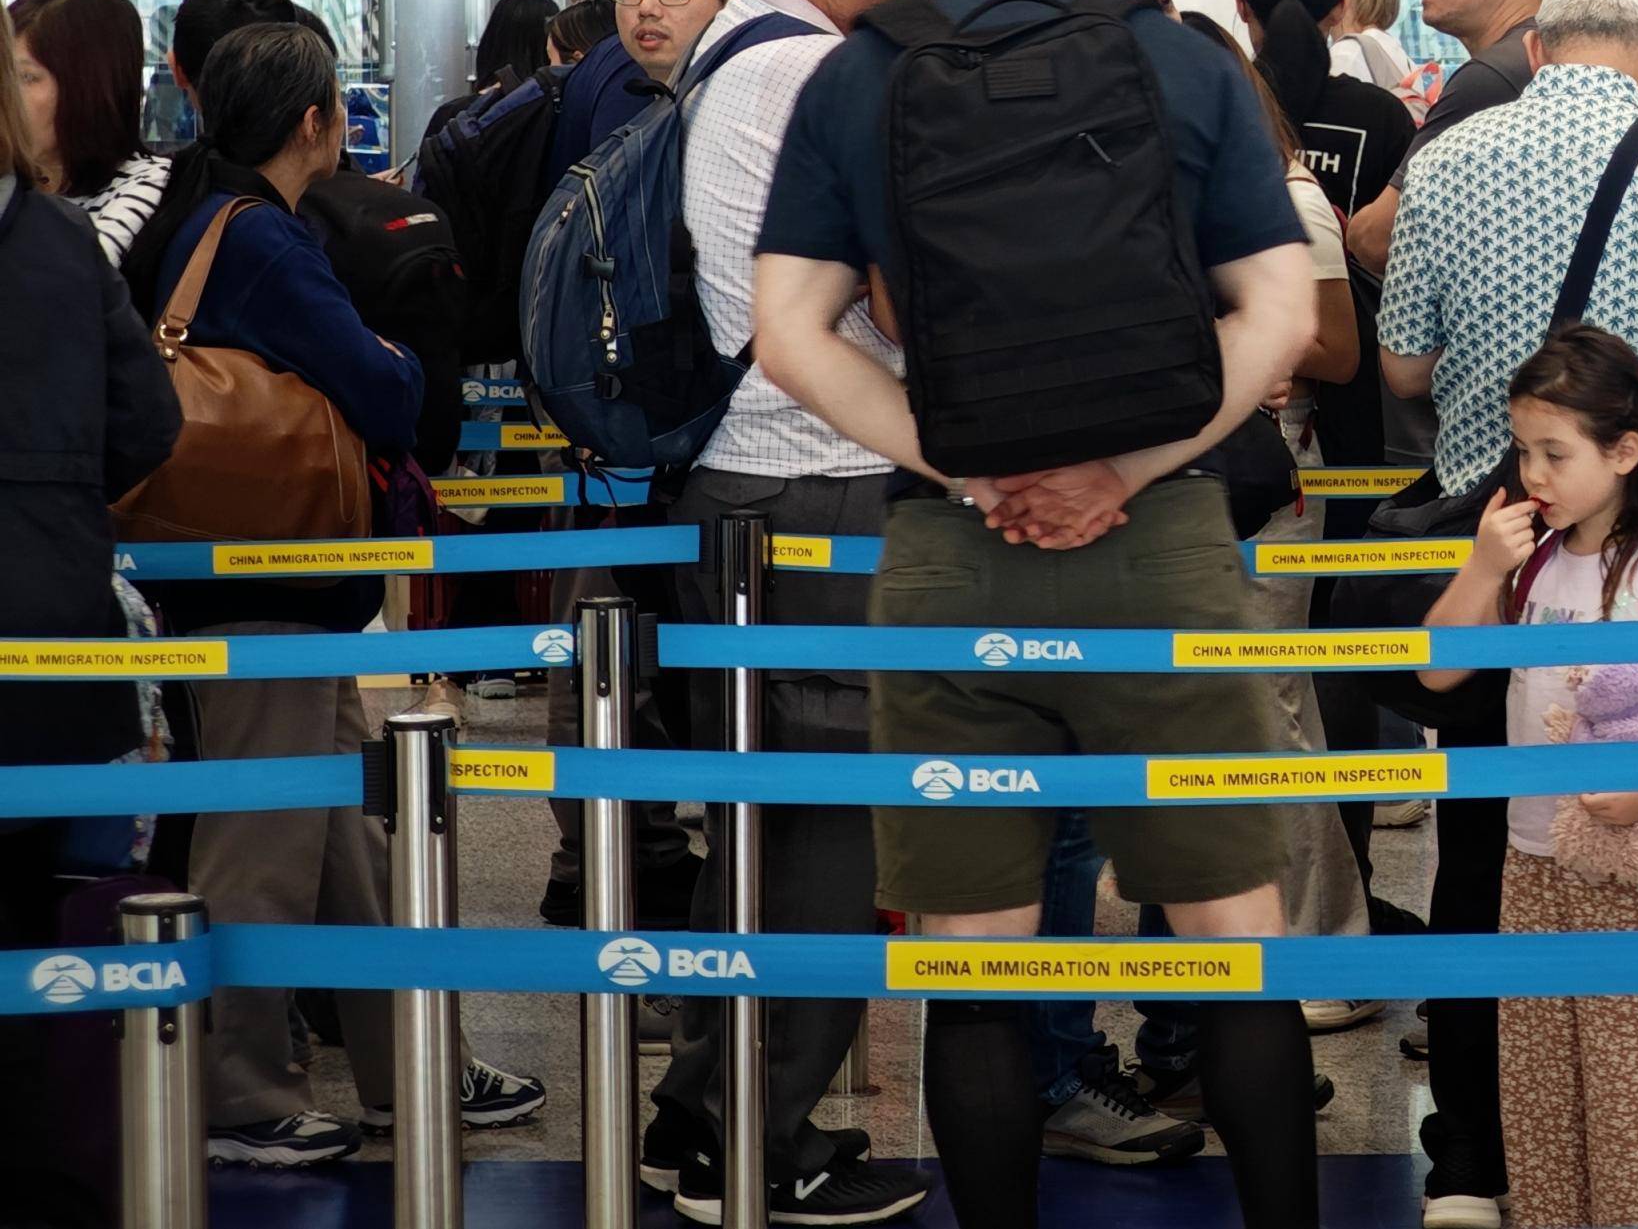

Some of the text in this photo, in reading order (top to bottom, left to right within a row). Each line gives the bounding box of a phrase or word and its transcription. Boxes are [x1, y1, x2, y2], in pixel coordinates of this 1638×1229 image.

[489, 486, 548, 496] INSPECTION
[1302, 478, 1369, 489] IMMIGRATION
[228, 551, 415, 566] CHINA IMMIGRATION INSPECTION
[1271, 550, 1457, 565] CHINA IMMIGRATION INSPECTION
[1022, 639, 1083, 660] BCIA
[1192, 643, 1409, 657] CHINA IMMIGRATION INSPECTION
[35, 654, 124, 665] IMMIGRATION
[130, 653, 207, 665] INSPECTION
[968, 768, 1041, 793] BCIA
[1169, 767, 1422, 787] CHINA IMMIGRATION INSPECTION
[668, 948, 756, 979] BCIA
[914, 960, 1231, 977] CHINA IMMIGRATION INSPECTION
[101, 961, 186, 992] BCIA
